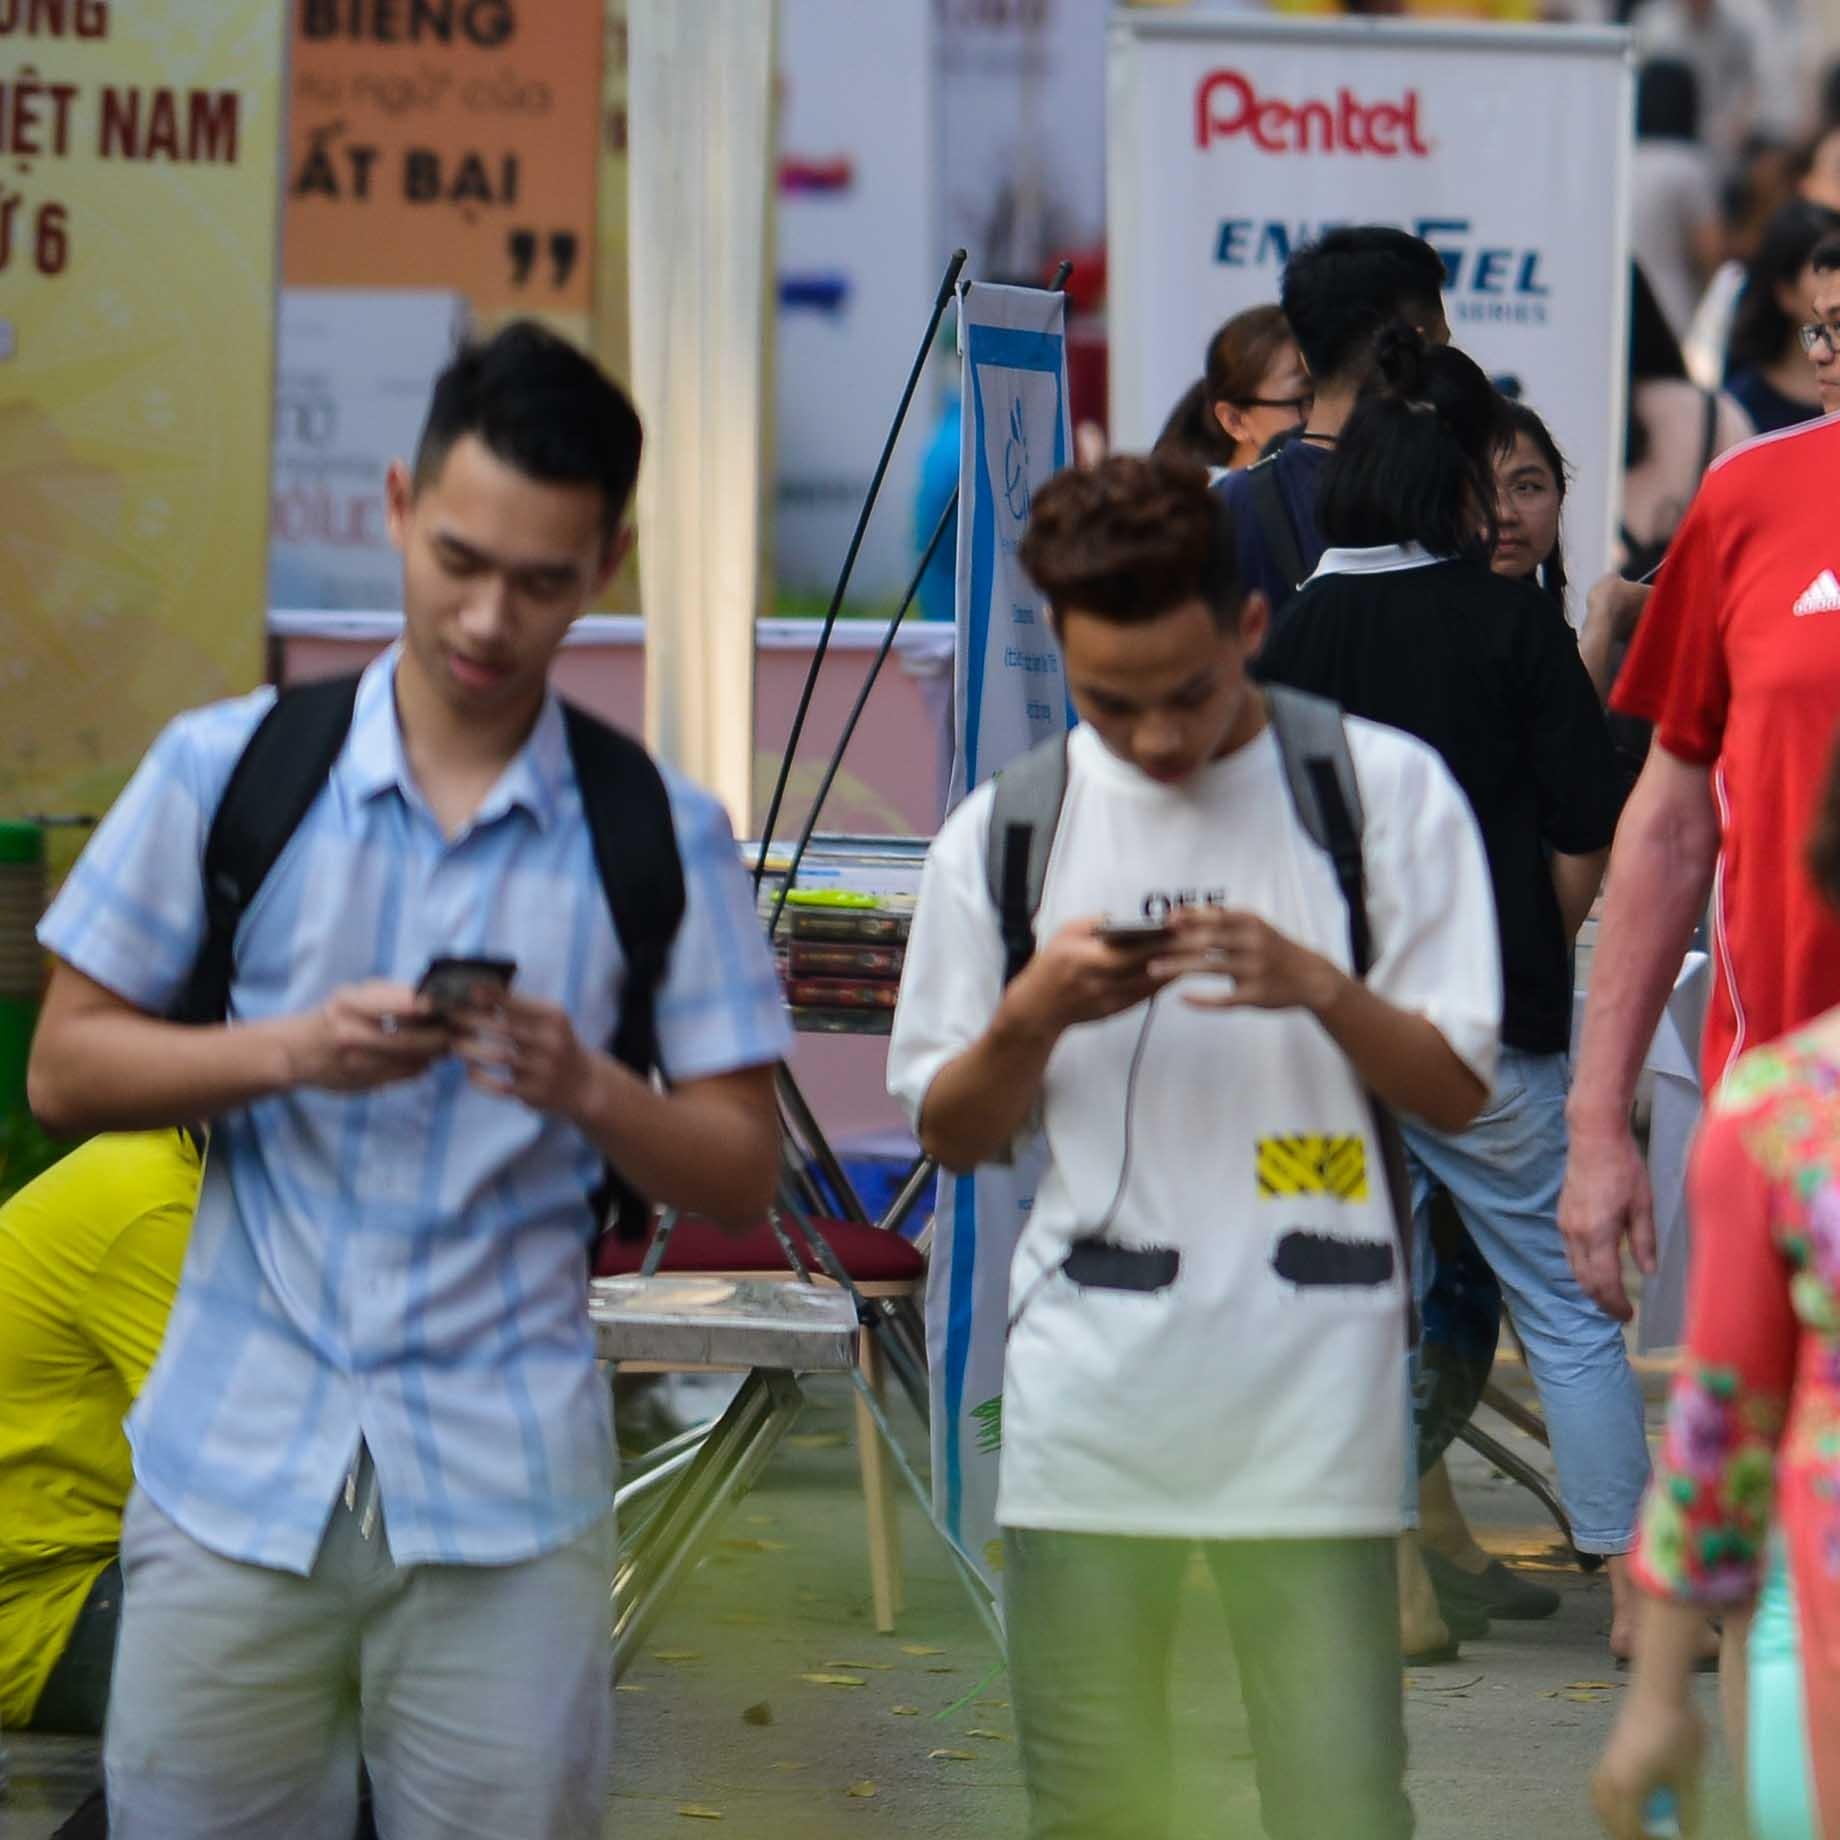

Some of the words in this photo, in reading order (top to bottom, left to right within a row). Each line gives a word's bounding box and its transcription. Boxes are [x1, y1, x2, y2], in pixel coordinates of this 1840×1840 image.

[99, 82, 241, 164] NAM
[1196, 68, 1430, 156] Pentel
[403, 145, 520, 223] BẠI
[34, 202, 68, 278] 6
